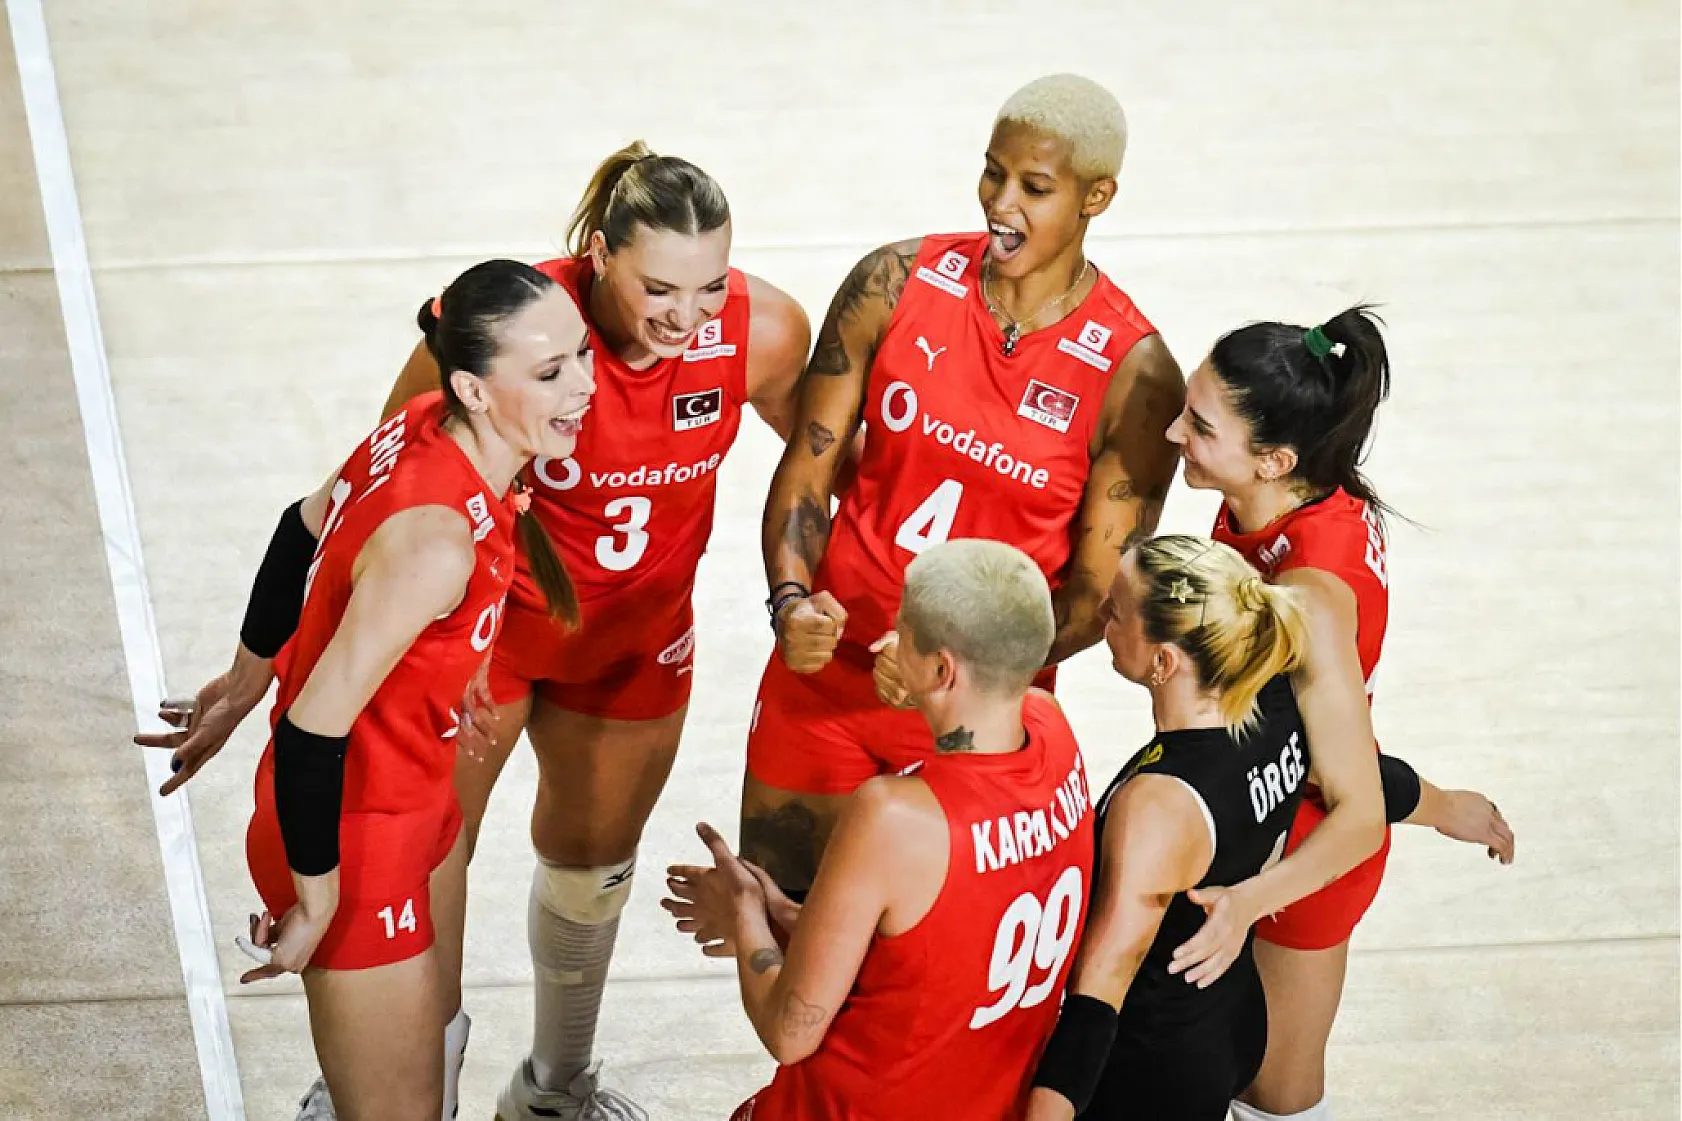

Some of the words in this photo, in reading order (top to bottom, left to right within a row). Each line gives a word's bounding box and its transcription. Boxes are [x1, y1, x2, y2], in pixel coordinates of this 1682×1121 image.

[945, 257, 961, 272] S
[703, 324, 717, 341] S
[1086, 328, 1103, 344] S
[589, 453, 721, 488] vodafone
[922, 411, 1050, 489] vodafone
[594, 496, 652, 571] 3
[895, 478, 964, 556] 4
[1246, 731, 1306, 825] ÖRGE
[377, 897, 417, 939] 14
[968, 865, 1083, 1031] 99
